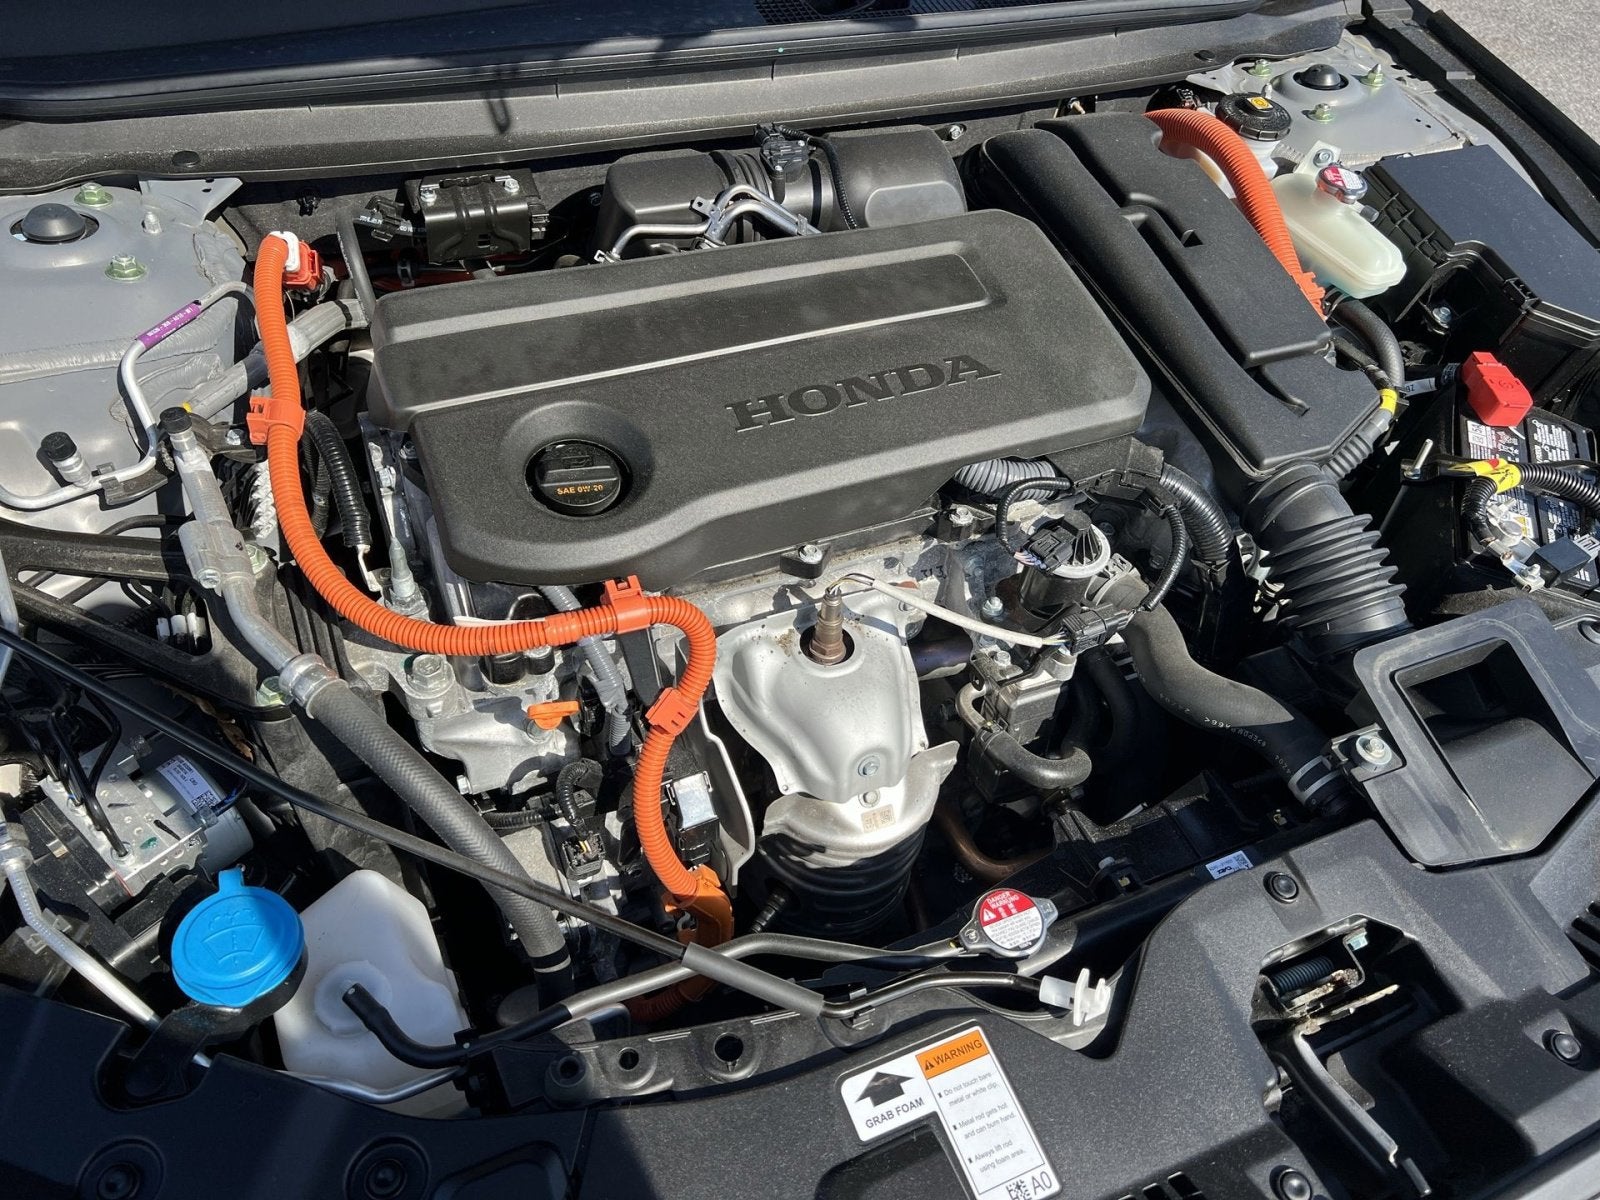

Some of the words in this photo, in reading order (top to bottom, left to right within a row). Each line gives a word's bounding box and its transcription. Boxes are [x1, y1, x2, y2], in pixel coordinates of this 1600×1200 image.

[725, 354, 1001, 431] HONDA
[556, 486, 575, 495] SAE
[932, 1039, 982, 1065] WARNING
[953, 1084, 963, 1092] not
[963, 1078, 979, 1088] touch
[979, 1072, 992, 1082] bare
[949, 1095, 965, 1106] metal
[971, 1086, 986, 1097] white
[865, 1108, 894, 1129] GRAB
[895, 1097, 925, 1115] FOAM
[959, 1117, 975, 1128] Metal
[975, 1112, 985, 1120] rod
[985, 1107, 998, 1117] gets
[998, 1102, 1008, 1110] hot
[964, 1129, 975, 1139] and
[976, 1126, 986, 1135] can
[987, 1120, 1000, 1130] burn
[975, 1148, 995, 1160] Always
[1002, 1139, 1013, 1148] rod
[980, 1162, 995, 1173] using
[995, 1155, 1011, 1165] foam
[1031, 1171, 1052, 1194] A0
